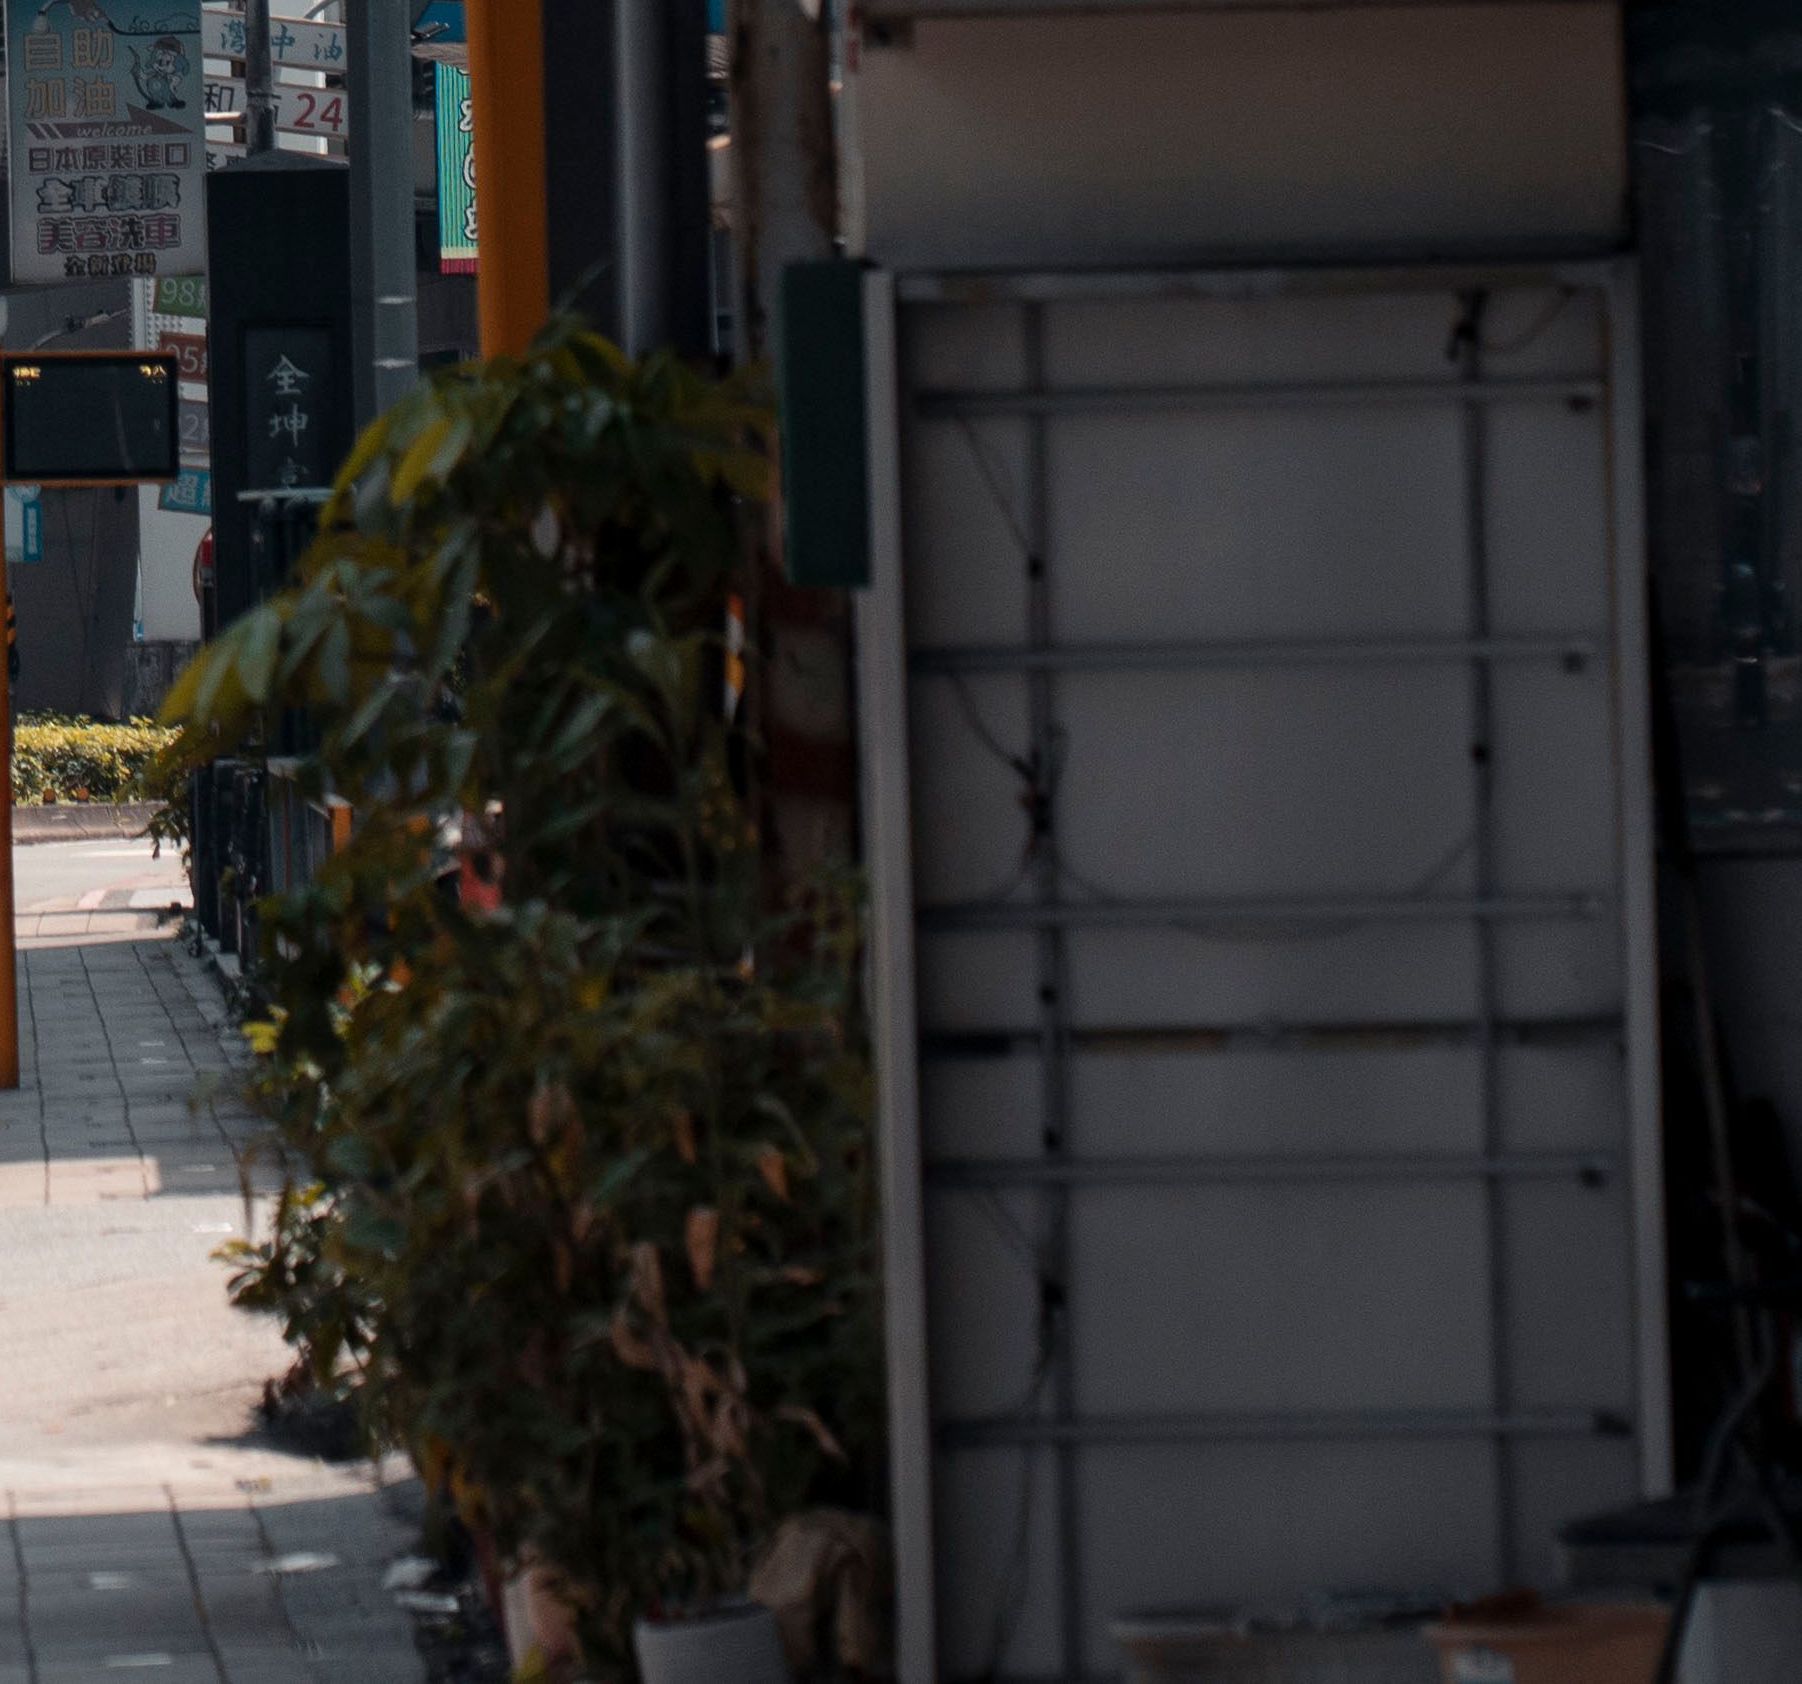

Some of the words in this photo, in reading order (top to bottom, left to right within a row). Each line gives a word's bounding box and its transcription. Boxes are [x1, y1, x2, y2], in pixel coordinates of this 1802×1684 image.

[24, 28, 114, 71] 自助
[25, 77, 116, 118] 加油
[294, 93, 343, 131] 24
[77, 122, 152, 137] welcome
[29, 143, 190, 174] 日本原裝進口
[38, 214, 180, 254] 美容洗車
